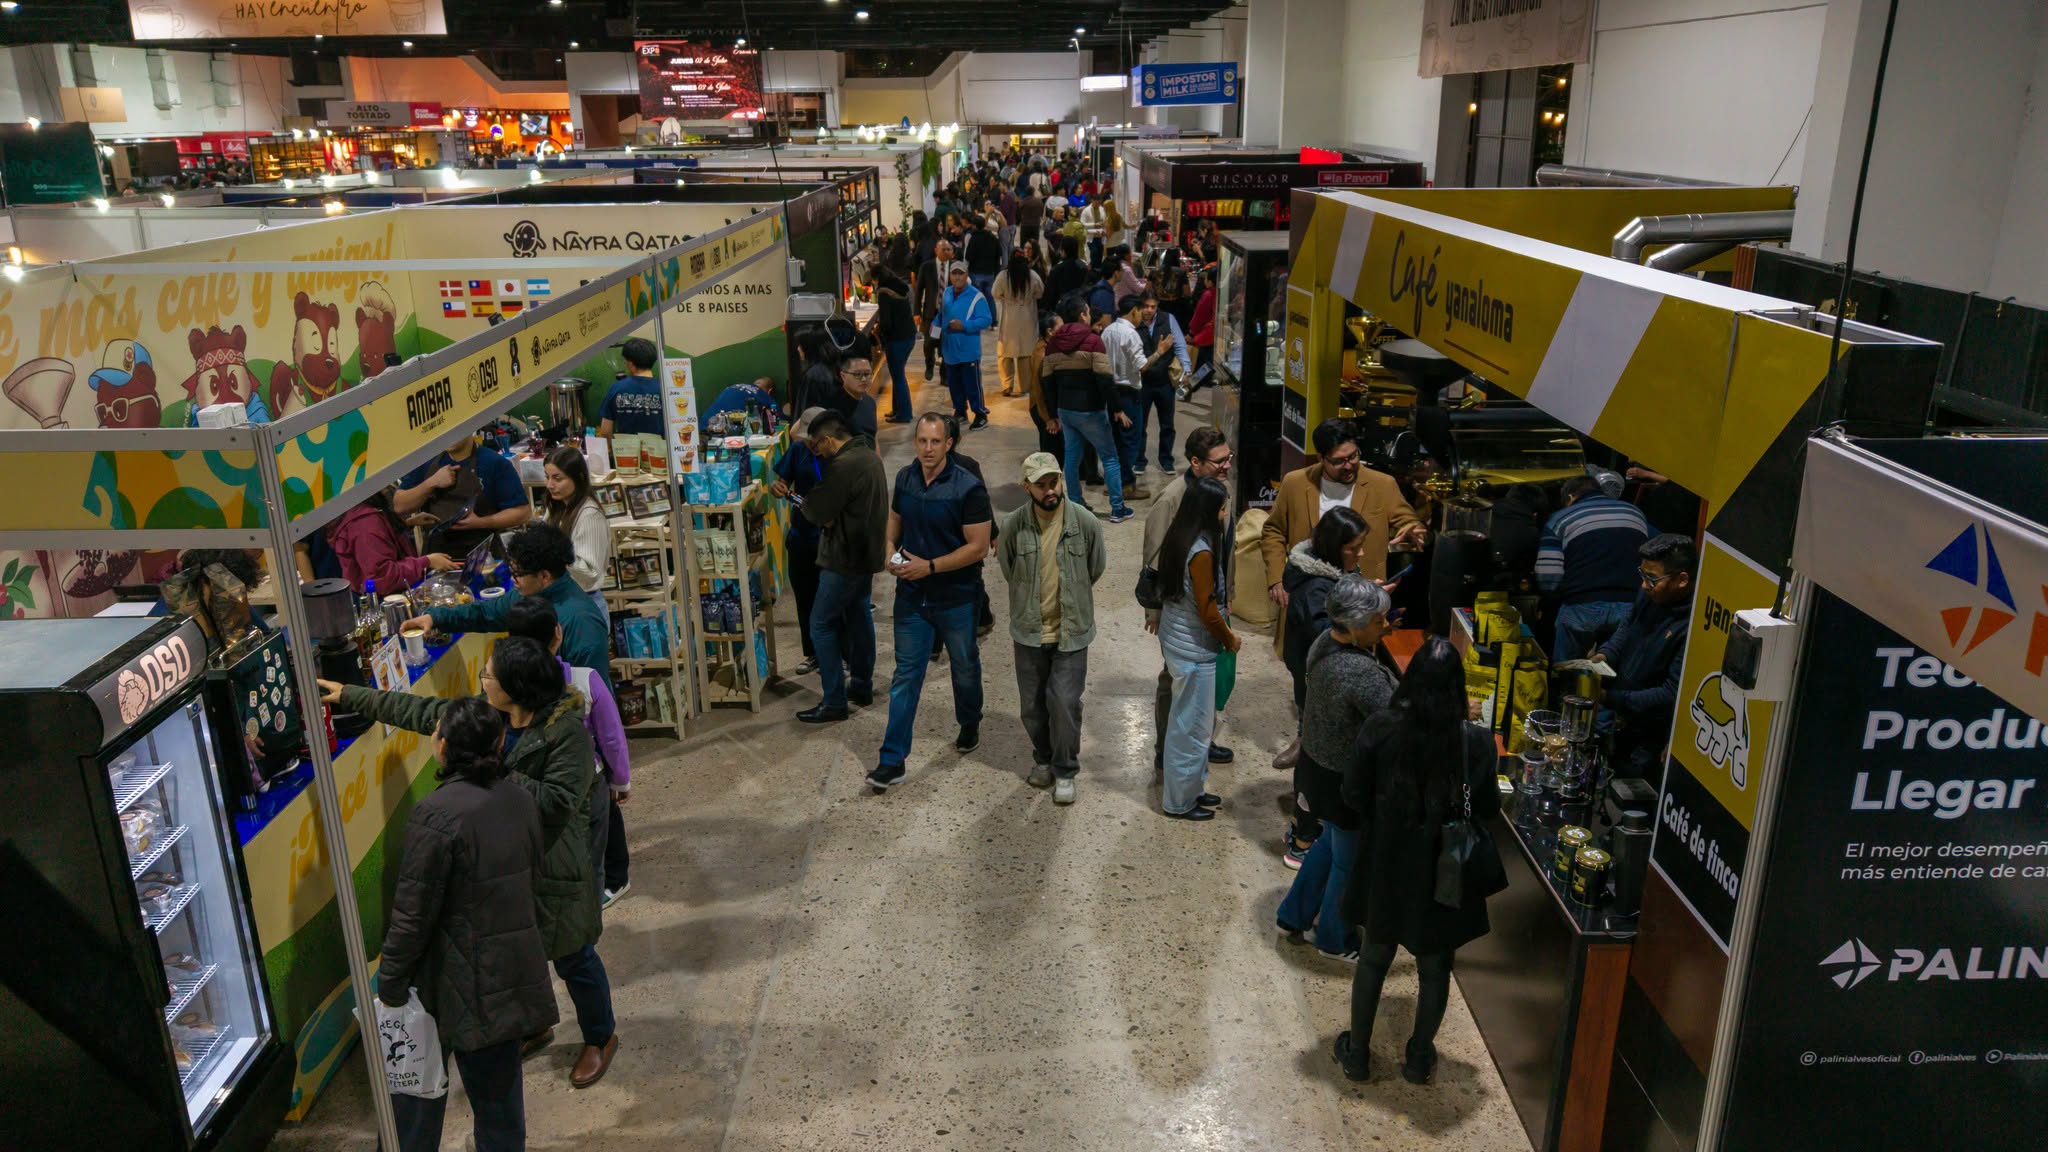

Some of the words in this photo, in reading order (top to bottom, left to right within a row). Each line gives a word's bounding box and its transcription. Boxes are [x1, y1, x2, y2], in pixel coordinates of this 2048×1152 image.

[235, 2, 267, 19] HAY
[1162, 72, 1217, 87] IMPOSTOR
[1163, 85, 1188, 97] MILK
[347, 111, 391, 120] TOSTADO
[357, 104, 379, 112] ALTO
[1200, 174, 1289, 184] TRICOLOR
[1344, 173, 1382, 184] Pavoni
[553, 231, 623, 251] NAYRA
[733, 284, 742, 296] A
[745, 284, 772, 296] MAS
[1390, 229, 1441, 338] Café
[1445, 278, 1514, 344] yanaloma
[677, 302, 693, 313] DE
[698, 302, 706, 313] 8
[708, 302, 749, 313] PAISES
[479, 356, 499, 393] OSO
[406, 375, 453, 430] AMBAR
[1704, 594, 1734, 635] yan
[139, 635, 191, 701] OSO
[1850, 770, 2037, 820] Llegar
[1662, 791, 1690, 845] Café
[1689, 824, 1705, 863] de
[1706, 838, 1740, 901] finca
[1845, 842, 1865, 858] El
[1870, 842, 1932, 861] mejor
[1840, 864, 1885, 880] más
[1890, 864, 1984, 880] entiende
[1989, 864, 2016, 879] de
[2021, 866, 2048, 878] ca
[1820, 1053, 1902, 1064] palinialvesoficial
[1925, 1052, 1977, 1064] palinialves
